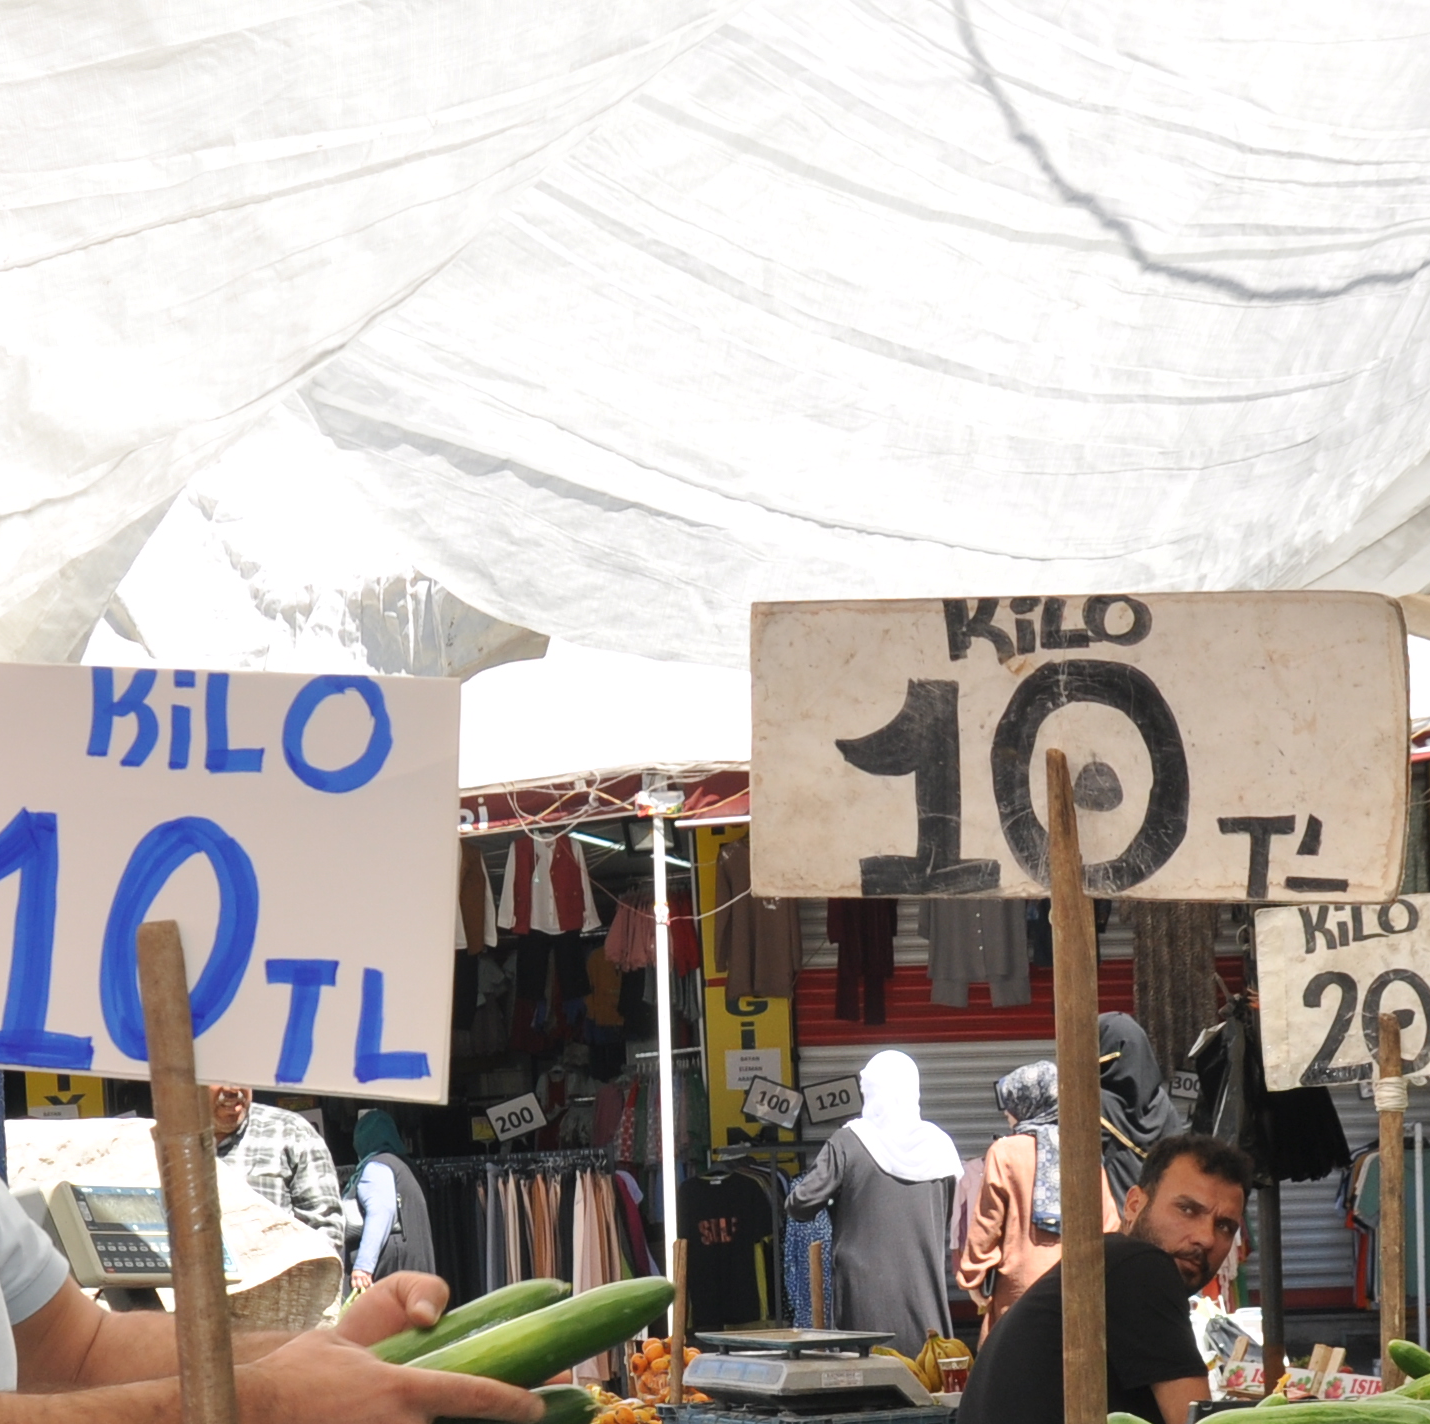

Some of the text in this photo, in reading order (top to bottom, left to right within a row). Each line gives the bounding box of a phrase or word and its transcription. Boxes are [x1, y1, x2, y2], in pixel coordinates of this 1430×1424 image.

[834, 658, 1190, 898] 10
[265, 959, 432, 1084] TL
[755, 1089, 791, 1115] 100
[815, 1088, 851, 1111] 120
[494, 1106, 534, 1135] 200
